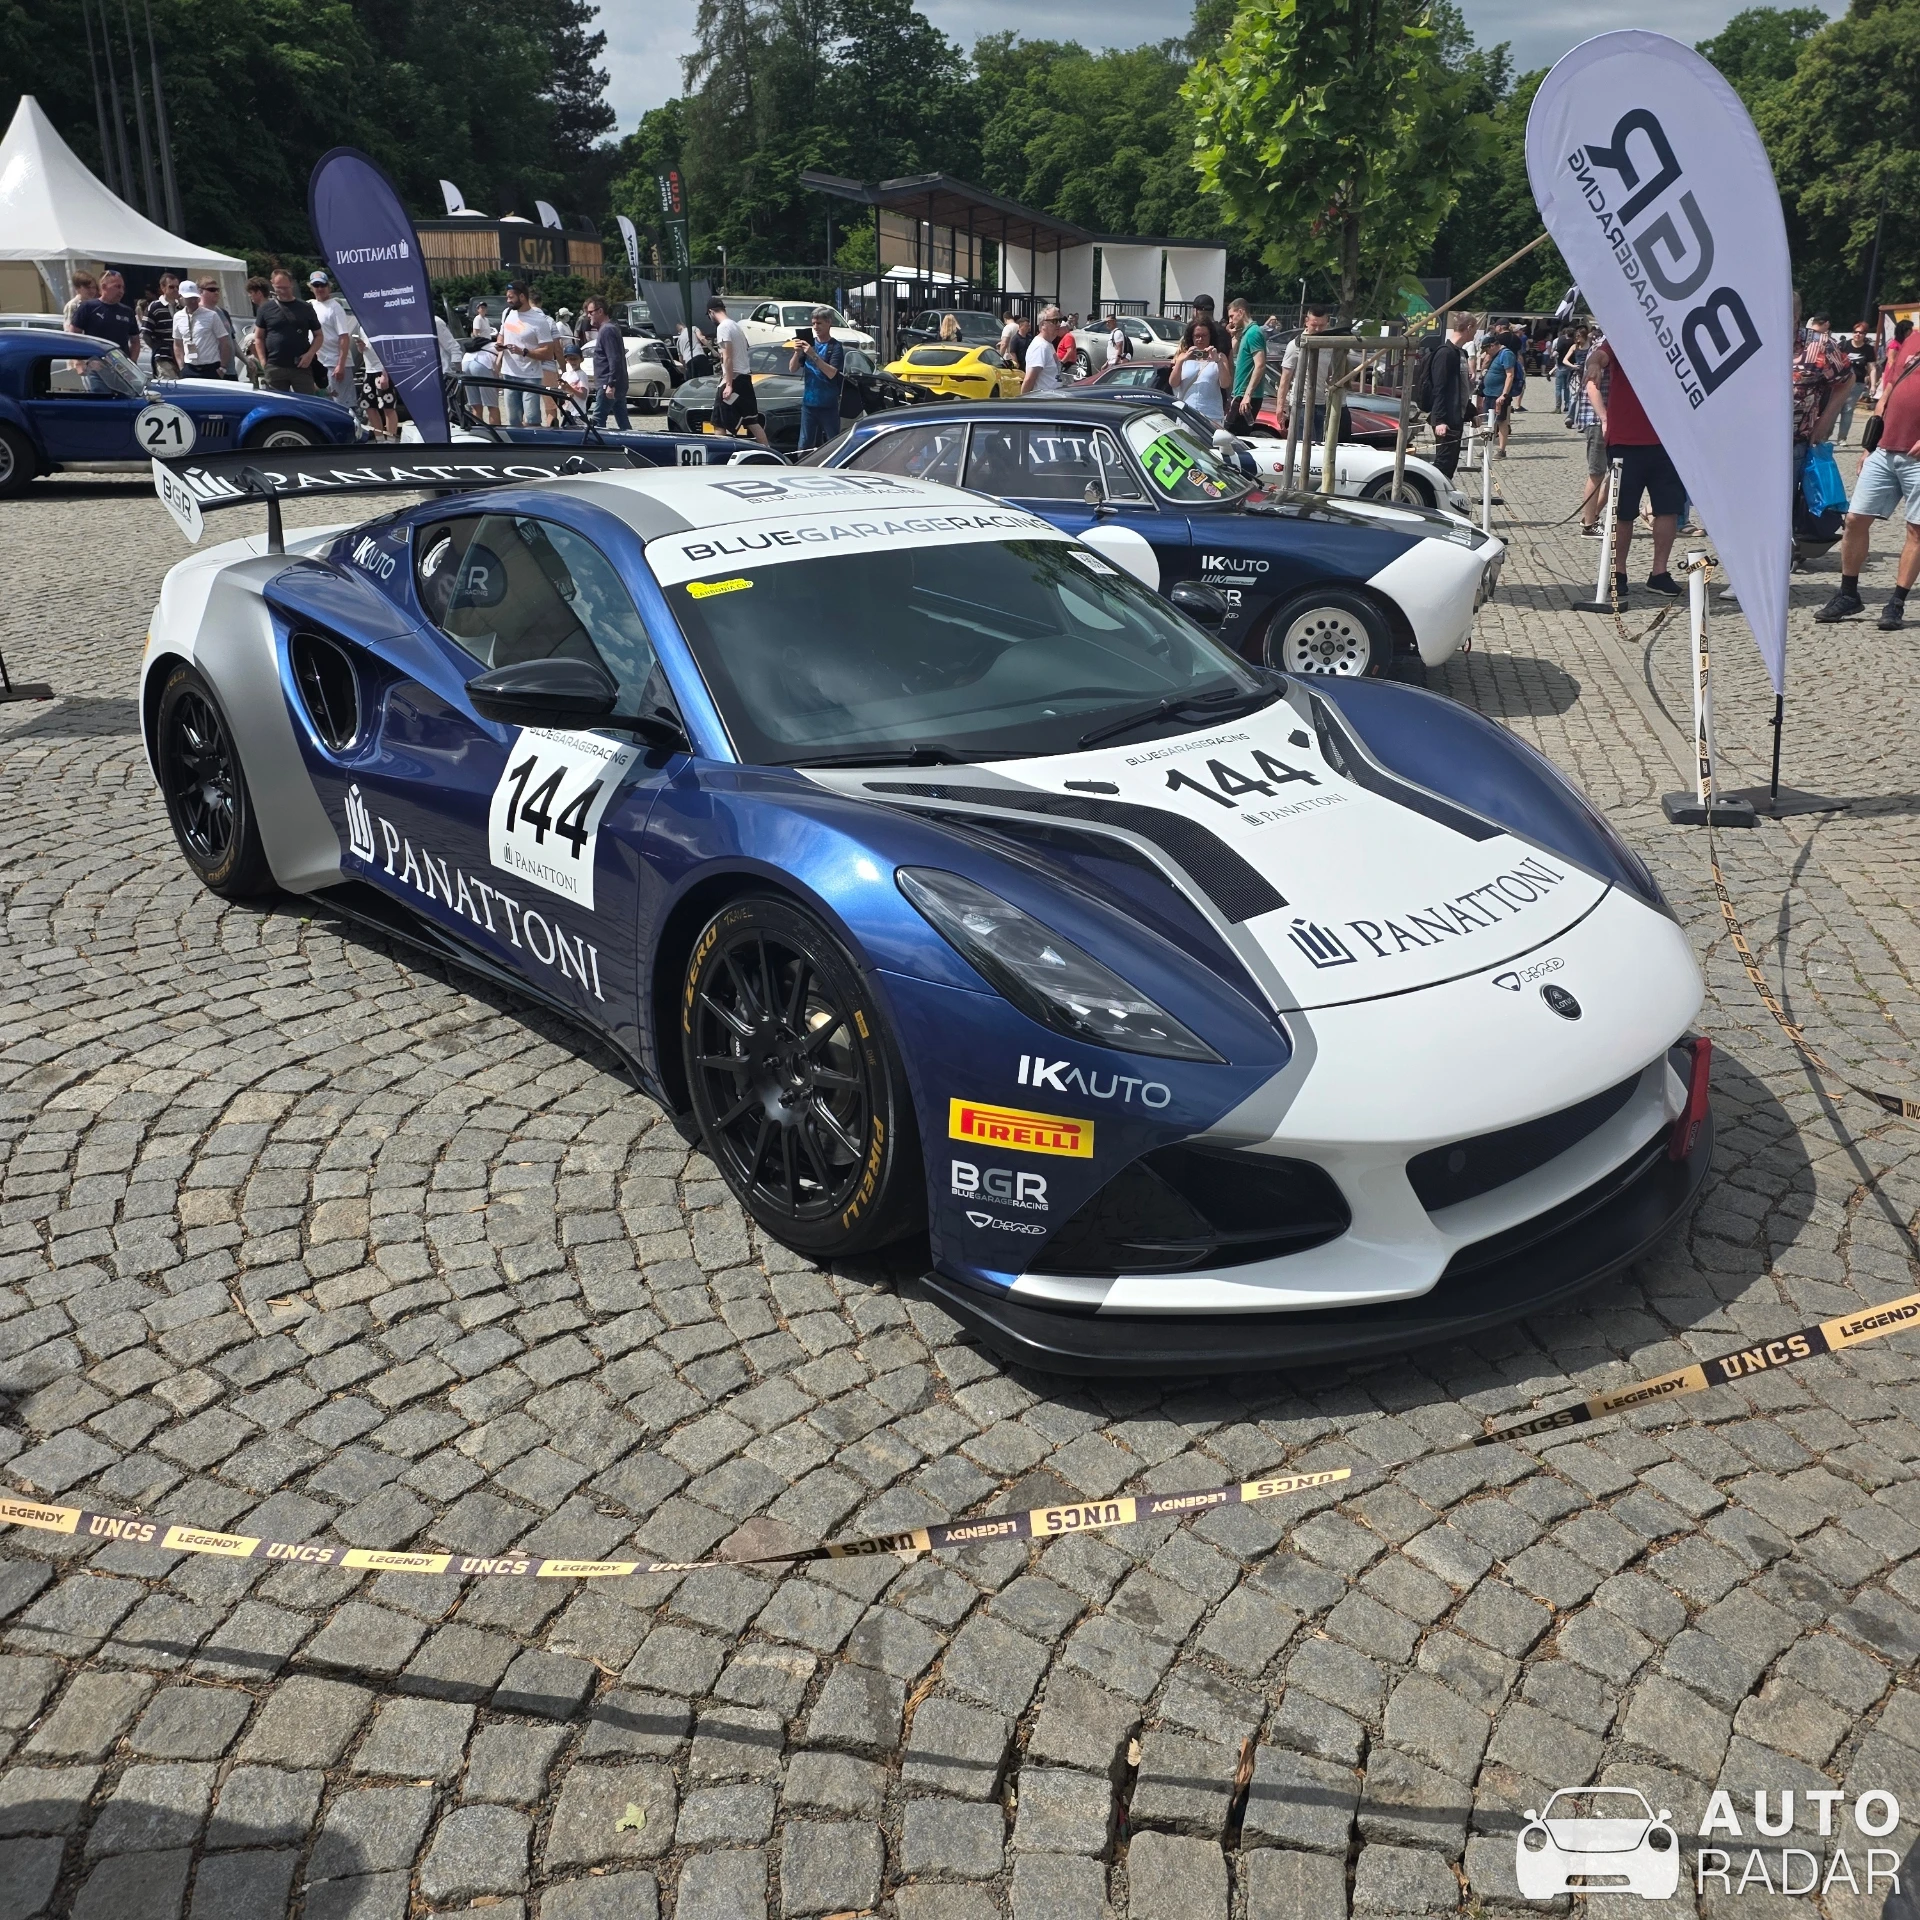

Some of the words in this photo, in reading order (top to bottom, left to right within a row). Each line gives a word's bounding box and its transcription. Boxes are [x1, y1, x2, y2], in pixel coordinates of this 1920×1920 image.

[145, 416, 183, 445] 21
[1141, 434, 1195, 491] 20
[163, 474, 191, 519] BGR
[706, 475, 908, 499] BGR
[681, 515, 1056, 562] BLUEGARAGERACING
[1125, 733, 1250, 766] BLUEGARAGERACING
[1165, 750, 1323, 809] 144
[506, 755, 604, 860] 144
[1259, 793, 1349, 822] PANATTONI
[514, 850, 578, 894] PANATTONI
[378, 816, 606, 1003] PANATTONI
[1344, 856, 1565, 958] PANATTONI
[685, 924, 717, 1008] ZERO
[1554, 996, 1576, 1009] LOTUS
[1017, 1054, 1171, 1108] IKAUTO
[960, 1107, 1082, 1150] PIRELLI
[842, 1114, 884, 1230] PIRELLI
[951, 1159, 1048, 1204] BGR
[951, 1187, 1049, 1211] BLUEGARAGERACING
[1719, 1334, 1812, 1379] UNCS
[1603, 1376, 1686, 1412] LEGENDY
[1492, 1411, 1574, 1443] UNCS
[1257, 1472, 1335, 1496] UNCS
[1, 1504, 65, 1524] LEGENDY
[1150, 1491, 1227, 1512] LEGENDY
[89, 1515, 157, 1543] UNCS
[944, 1520, 1017, 1542] LEGENDY
[1046, 1504, 1121, 1532] UNCS
[176, 1532, 242, 1549] LEGENDY
[266, 1542, 336, 1562] UNCS
[841, 1533, 916, 1556] UNCS
[367, 1554, 431, 1567] LEGENDY
[460, 1556, 531, 1575] UNCS
[552, 1563, 620, 1573] LEGENDY
